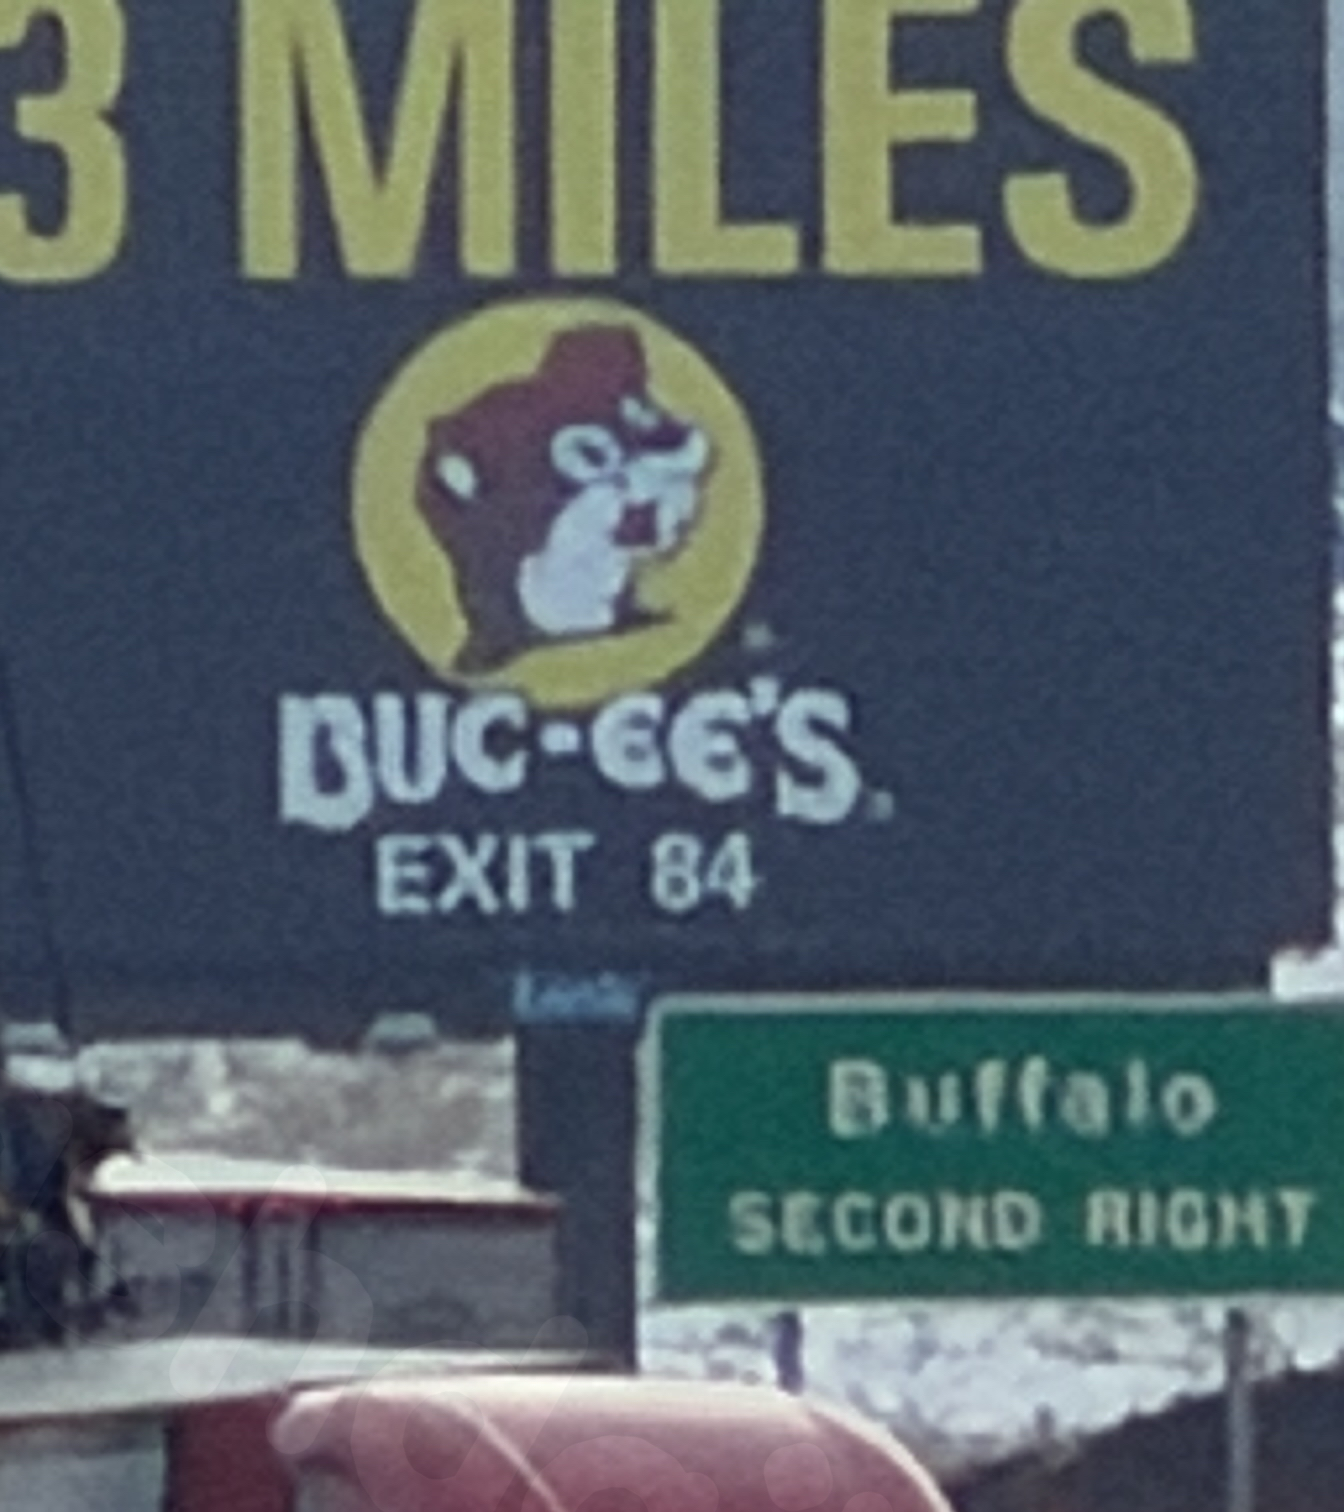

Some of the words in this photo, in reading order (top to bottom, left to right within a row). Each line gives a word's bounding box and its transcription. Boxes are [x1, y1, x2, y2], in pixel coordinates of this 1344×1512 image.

[239, 0, 1199, 278] MILES
[375, 832, 596, 914] EXIT
[650, 832, 762, 913] 84
[828, 1056, 1218, 1138] Buffalo
[728, 1190, 1042, 1254] SECOND
[1086, 1190, 1319, 1251] RIGHT
